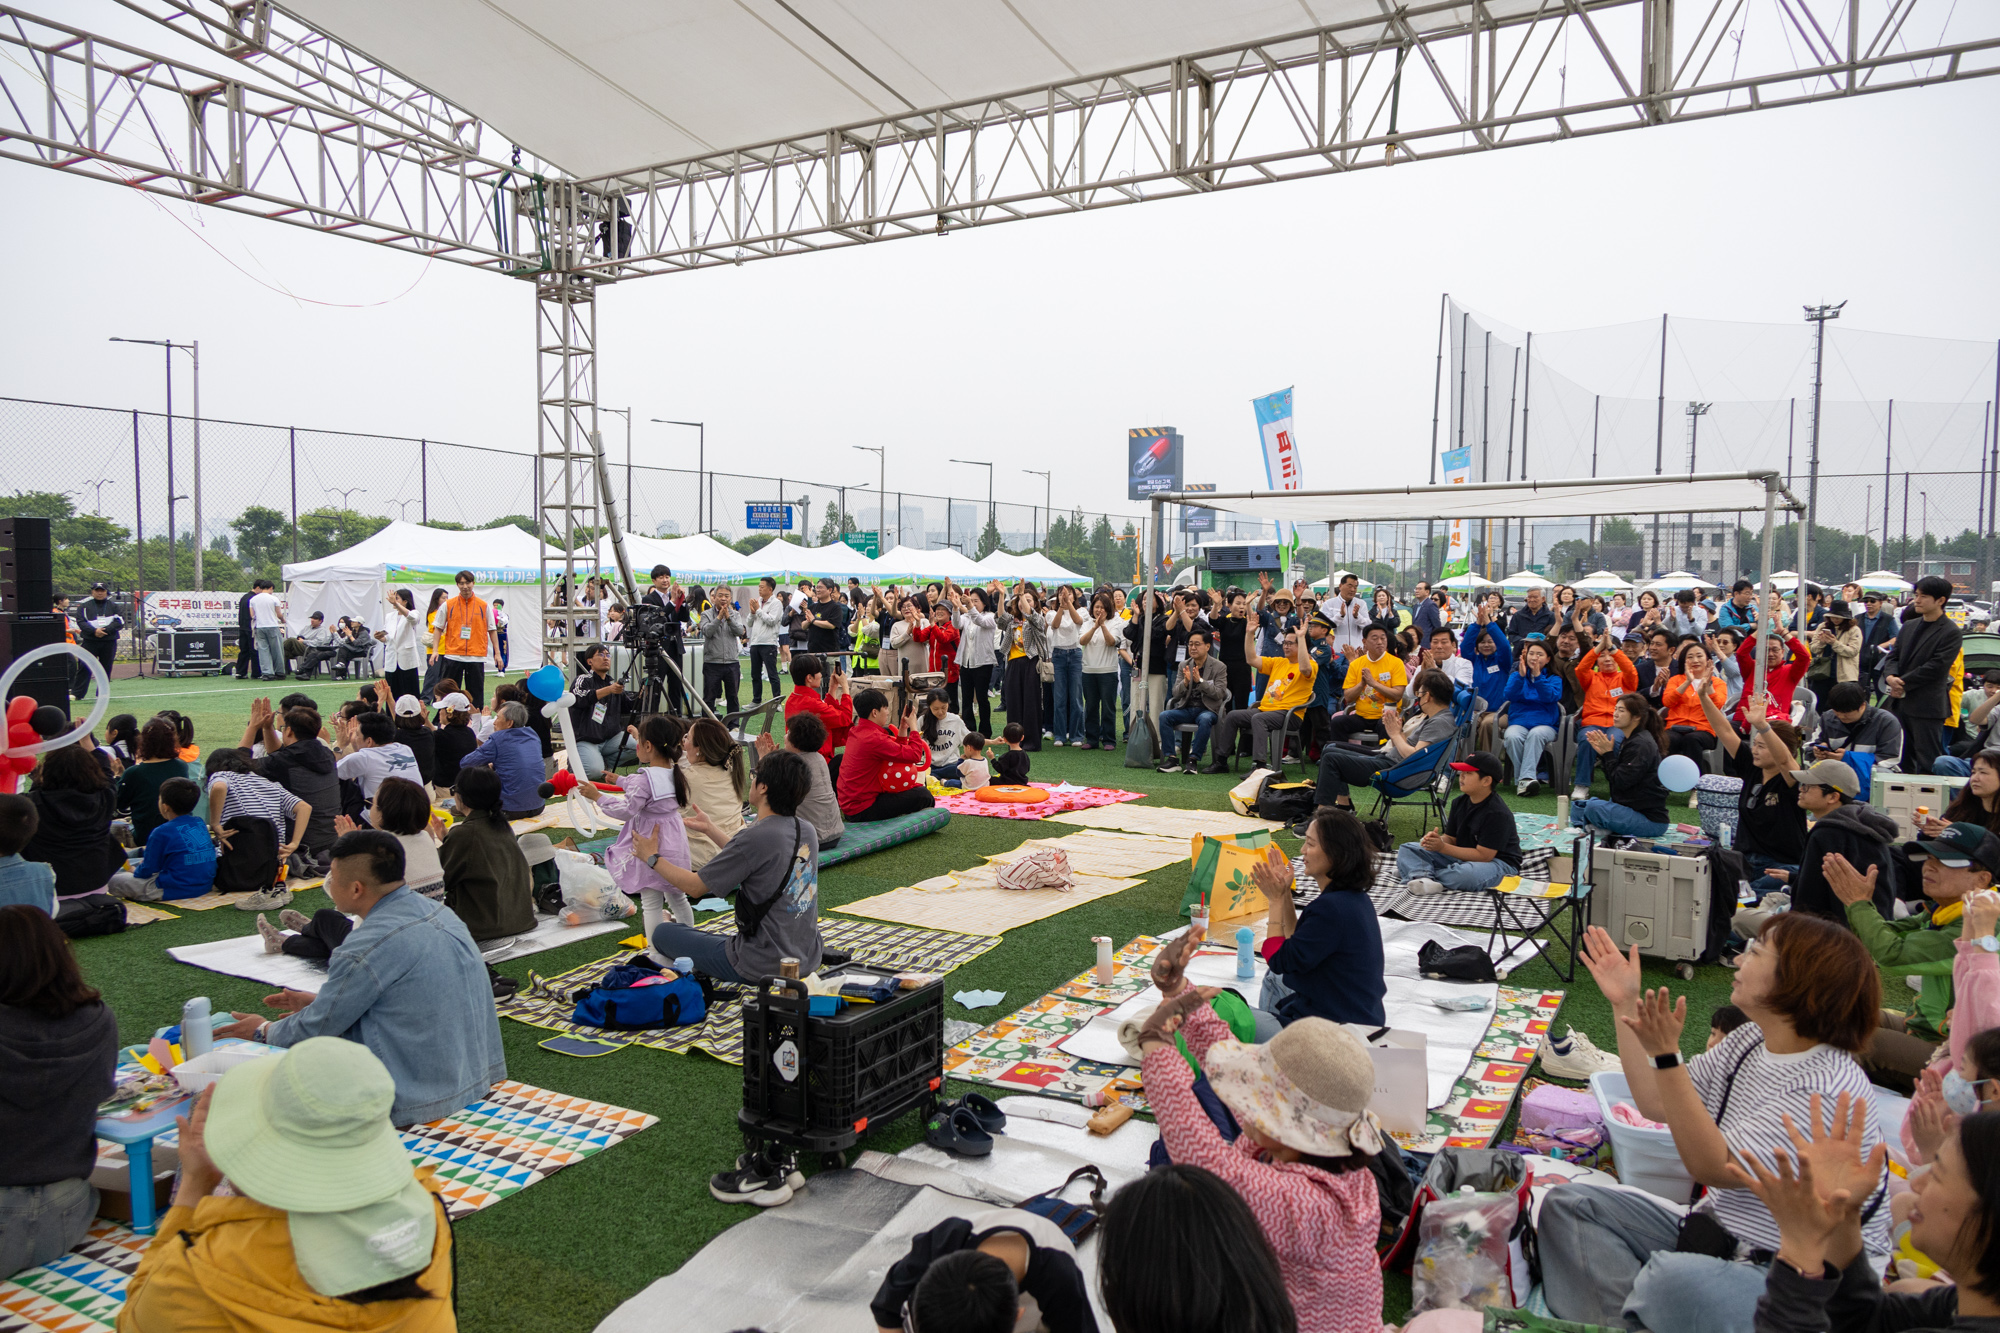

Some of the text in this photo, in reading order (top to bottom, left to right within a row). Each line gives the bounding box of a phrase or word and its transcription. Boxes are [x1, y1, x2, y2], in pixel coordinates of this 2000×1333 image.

[473, 570, 556, 584] 여자 대기실 1)
[675, 572, 744, 585] 참여자 대기실 (2)
[158, 599, 201, 610] 축구공이
[204, 600, 231, 610] 펜스를
